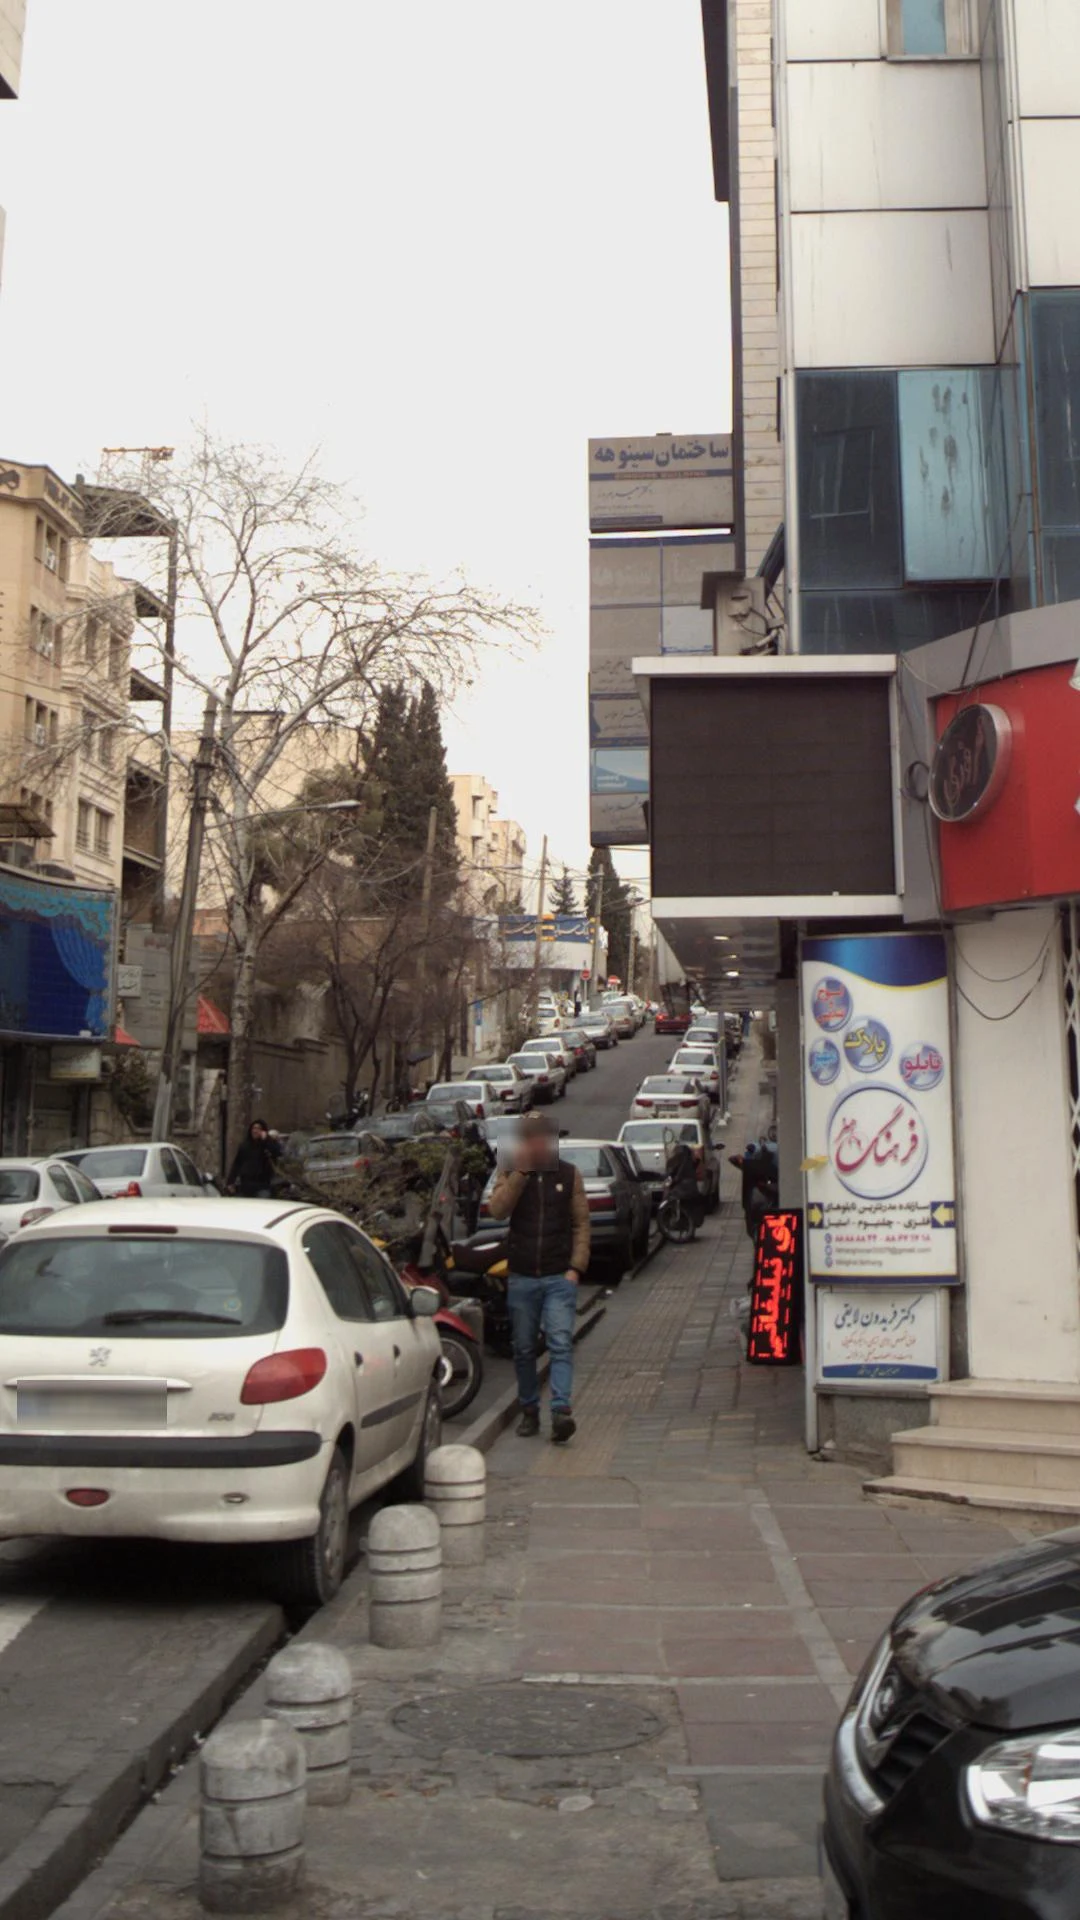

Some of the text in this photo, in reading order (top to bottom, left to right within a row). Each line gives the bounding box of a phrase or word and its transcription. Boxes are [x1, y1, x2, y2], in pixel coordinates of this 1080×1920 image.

[655, 440, 729, 467] ساختمان
[844, 1027, 887, 1063] پلاک
[903, 1051, 944, 1082] تابلو
[835, 1103, 919, 1174] فرهنگ
[861, 1303, 898, 1332] فریدون
[891, 1294, 921, 1332] دکتر
